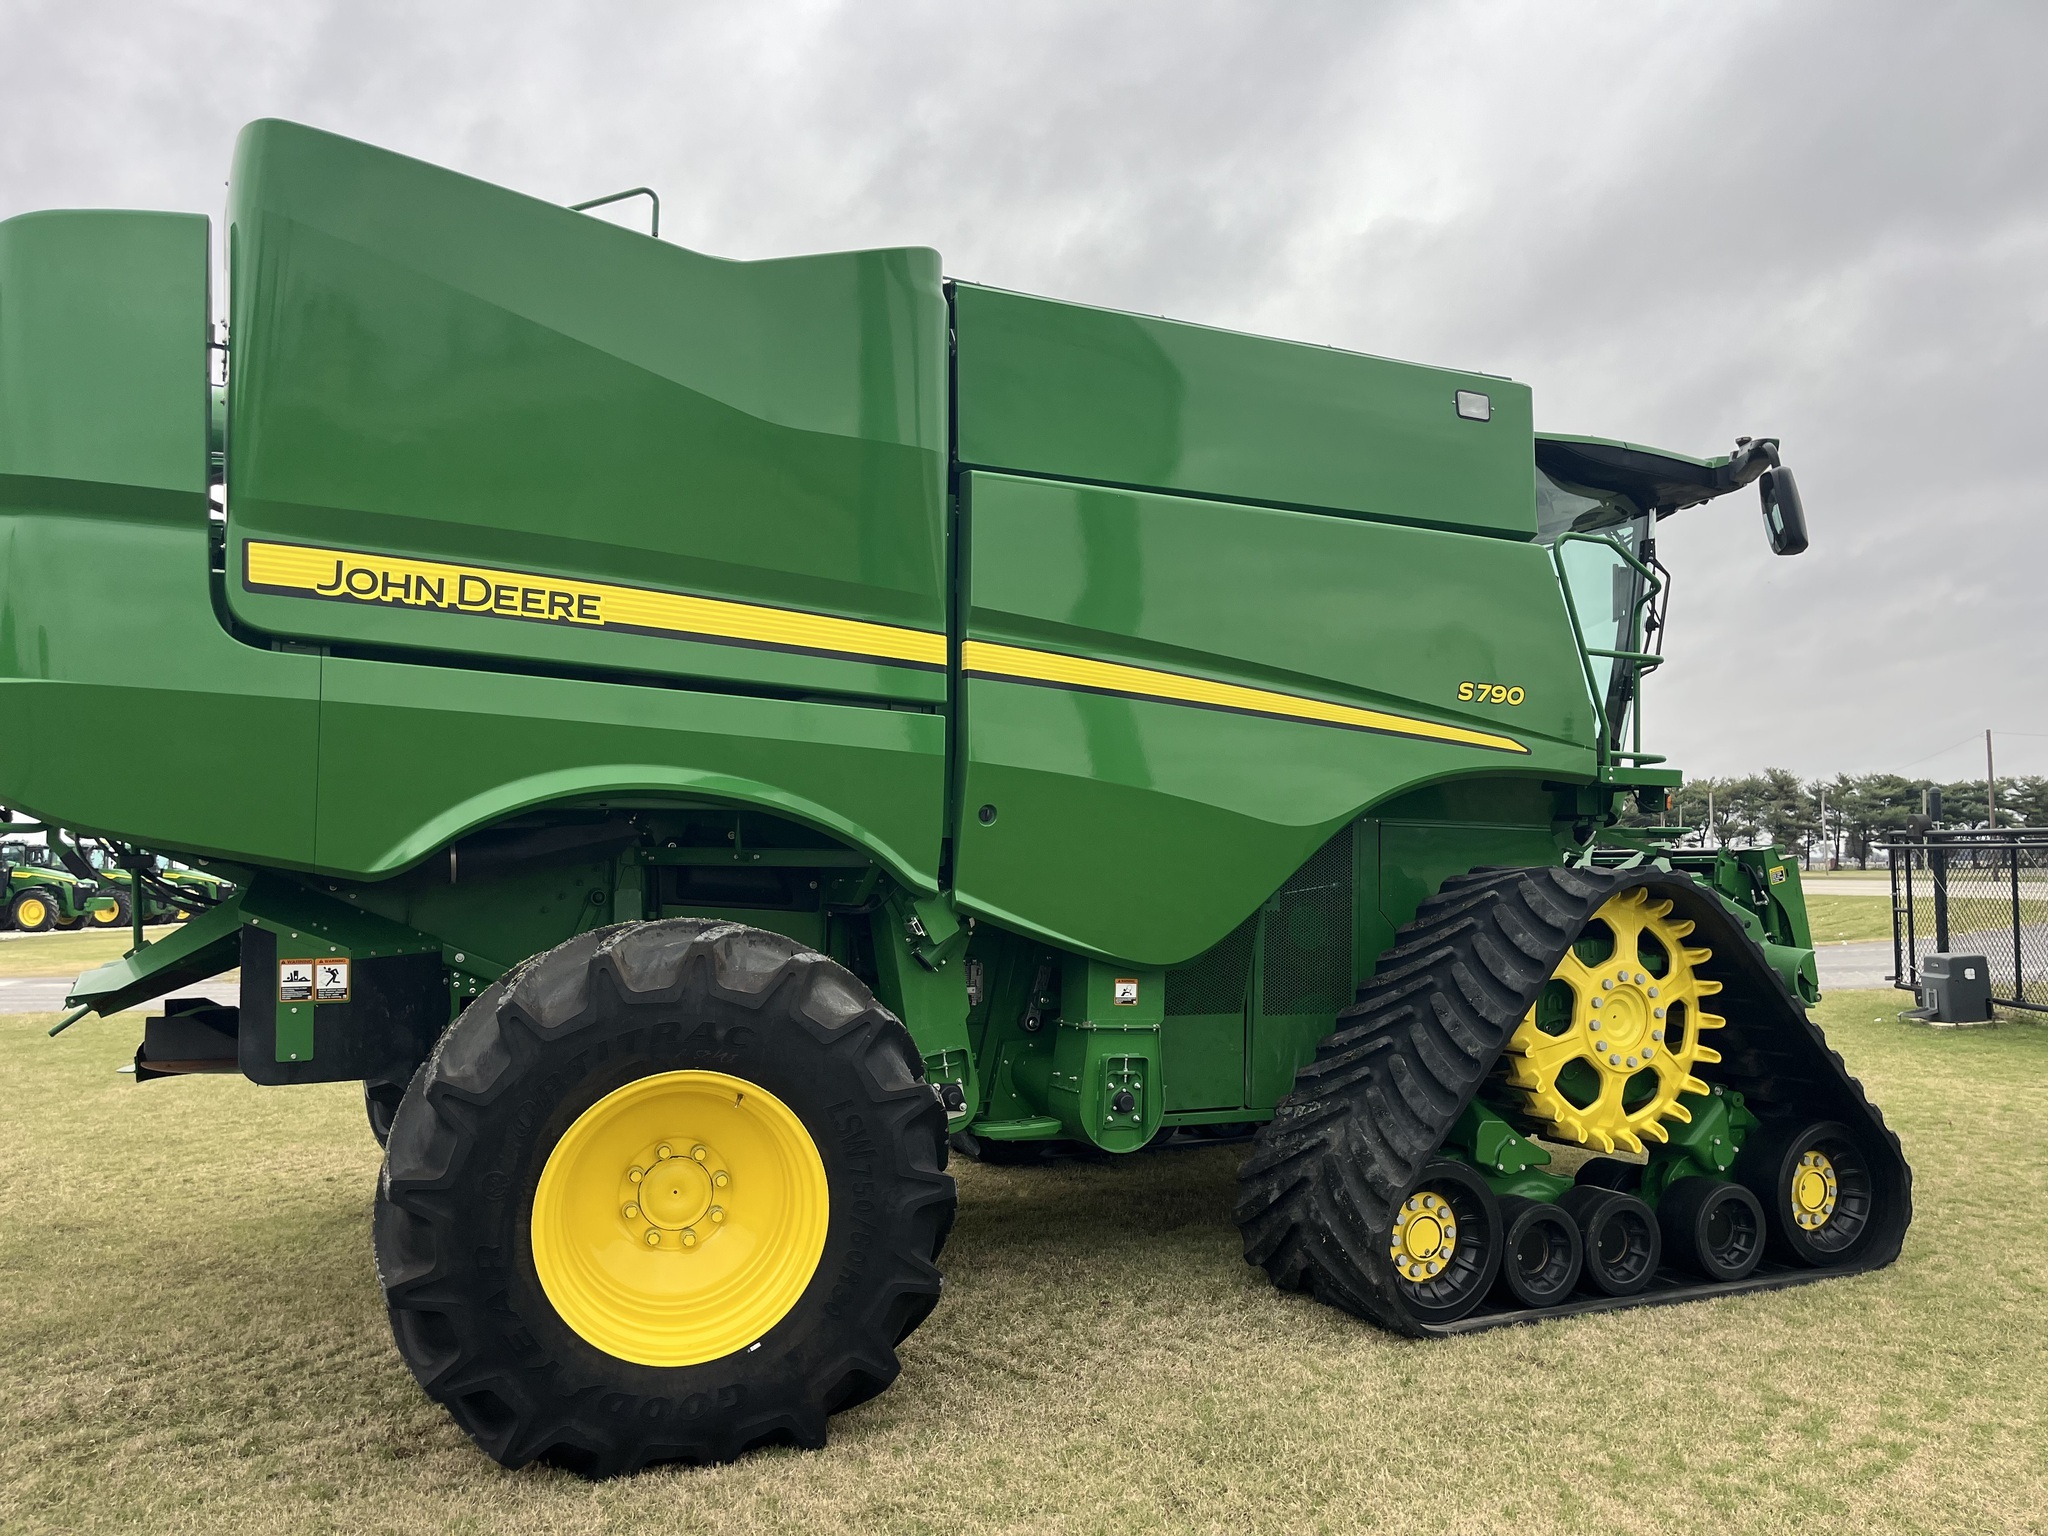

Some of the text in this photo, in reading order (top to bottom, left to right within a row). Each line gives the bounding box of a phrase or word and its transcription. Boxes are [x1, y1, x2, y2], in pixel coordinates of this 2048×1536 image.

[316, 560, 603, 622] JOHN DEERE
[1457, 681, 1525, 706] S790
[511, 1021, 756, 1137] OPTITRAC
